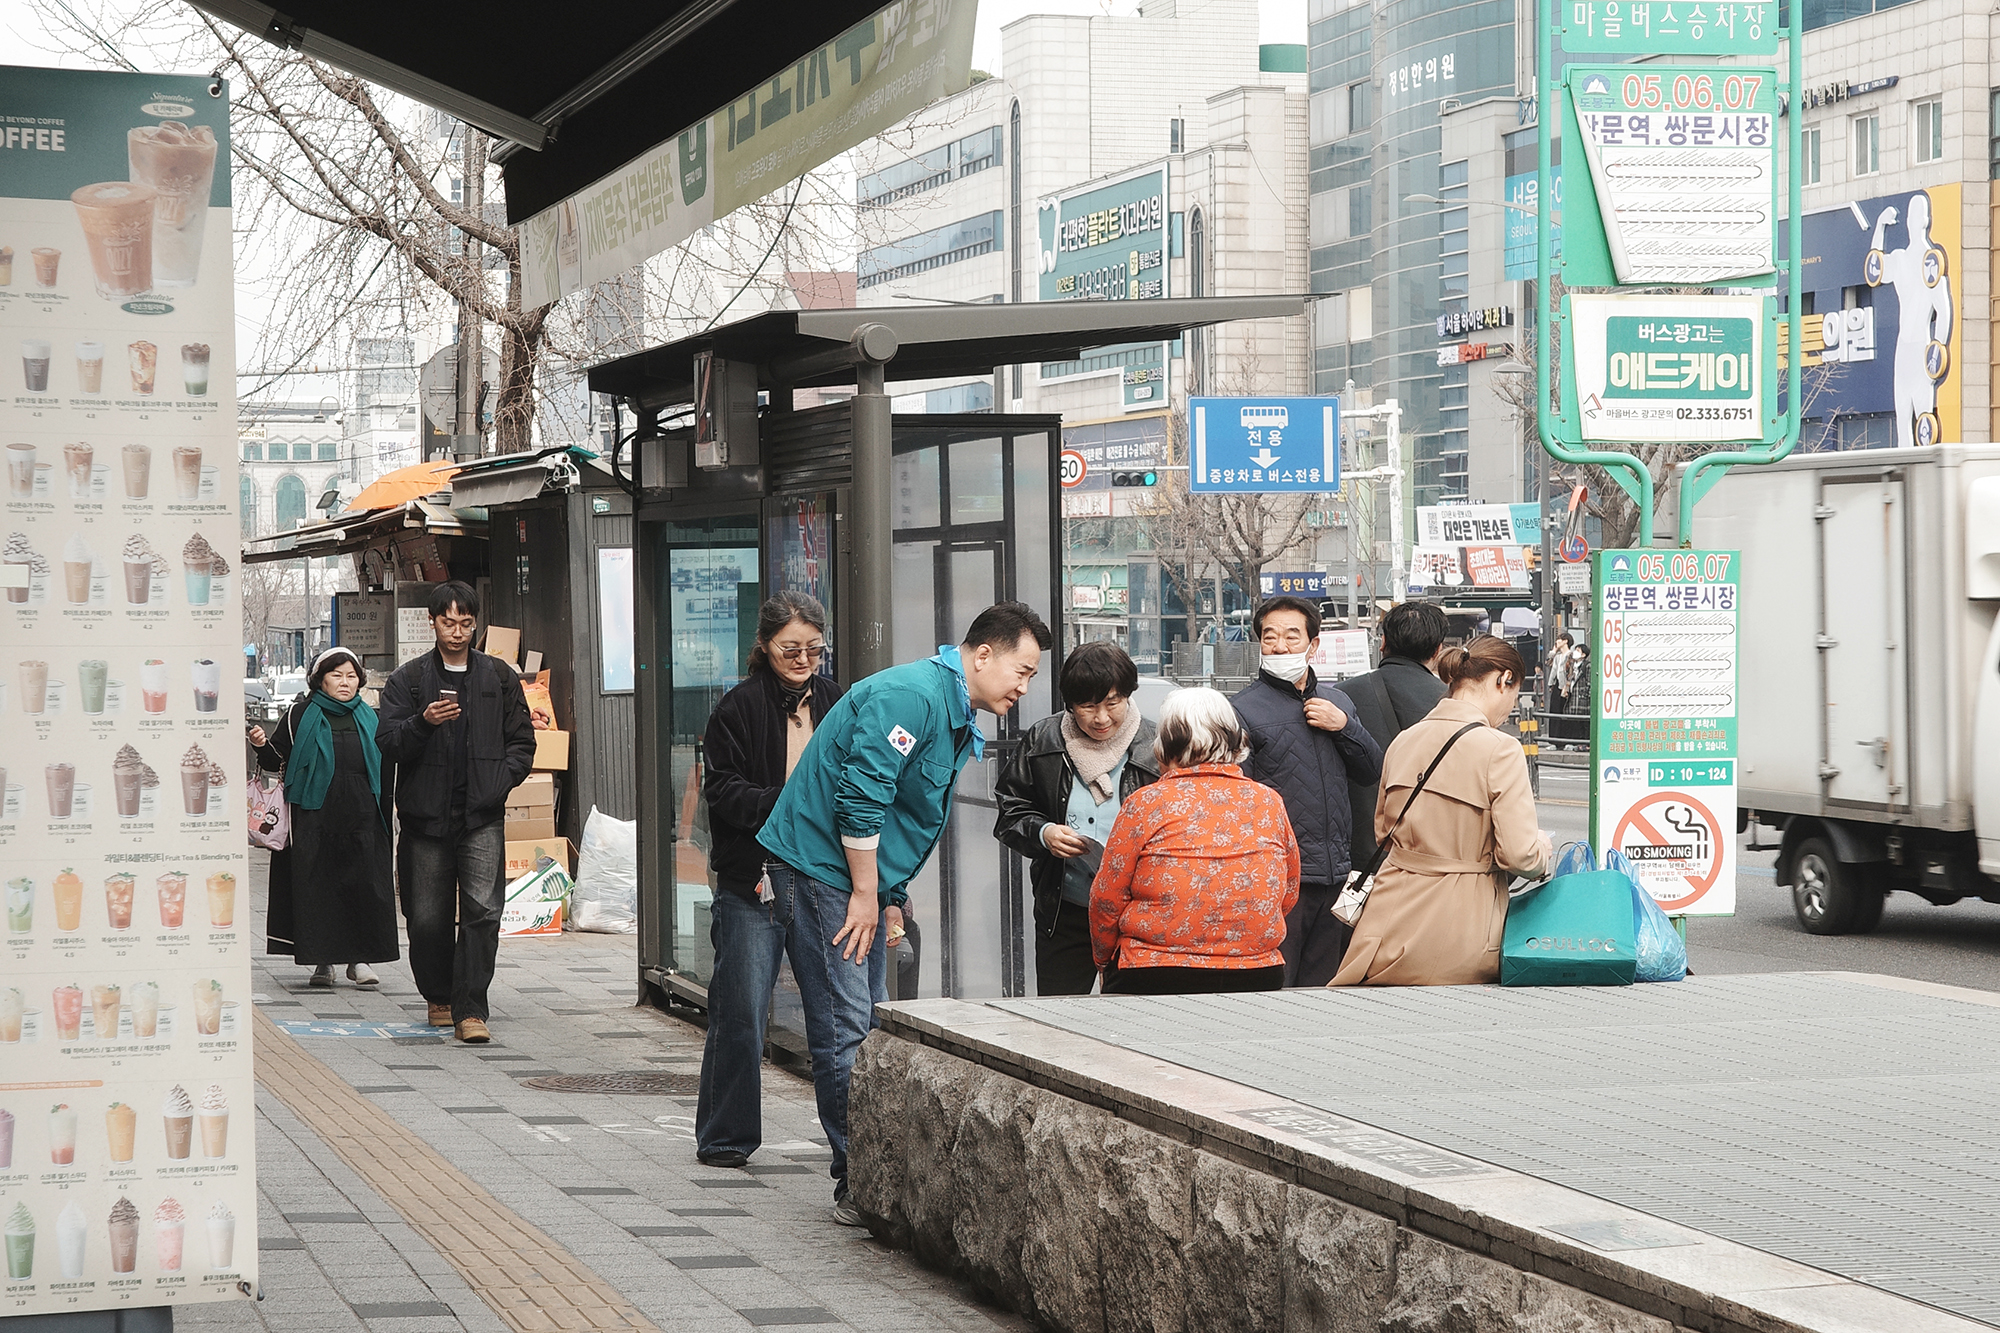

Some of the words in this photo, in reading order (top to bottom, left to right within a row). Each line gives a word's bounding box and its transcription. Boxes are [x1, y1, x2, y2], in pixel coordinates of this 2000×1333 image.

[1574, 2, 1766, 40] 마을버스승차장
[1389, 53, 1455, 97] 정인한의원
[1622, 75, 1762, 112] 05.06.07
[1580, 97, 1616, 108] 도봉구
[6, 116, 36, 125] BEYOND
[37, 117, 65, 126] COFFEE
[1638, 323, 1726, 344] 버스광고는
[1609, 352, 1750, 391] 애드케이
[1606, 408, 1639, 419] 마을버스
[1641, 408, 1674, 419] 광고문의
[1676, 407, 1753, 420] 02.333.6751
[1210, 468, 1264, 483] 중앙차로
[1268, 468, 1322, 483] 버스전용
[1443, 520, 1473, 541] 대안은
[1472, 519, 1511, 540] 기본소득
[1638, 554, 1731, 583] 05.06.07
[1610, 573, 1634, 582] 도봉구
[1606, 586, 1734, 611] 쌍문역.쌍문시장
[346, 612, 366, 621] 3000
[1604, 619, 1622, 643] 05
[1604, 654, 1622, 678] 06
[1604, 689, 1622, 713] 07
[1620, 719, 1641, 730] 이곳에
[1695, 719, 1717, 729] 부착시
[1683, 741, 1694, 751] 받을
[1697, 742, 1702, 751] 수
[1705, 741, 1729, 751] 있습니다.
[1650, 768, 1664, 781] ID
[1680, 768, 1693, 781] 10
[1708, 767, 1727, 780] 124
[201, 854, 230, 862] Blending
[231, 853, 244, 861] Tea
[1626, 847, 1641, 859] NO
[1643, 846, 1692, 858] SMOKING
[1525, 937, 1617, 952] OSULLOC
